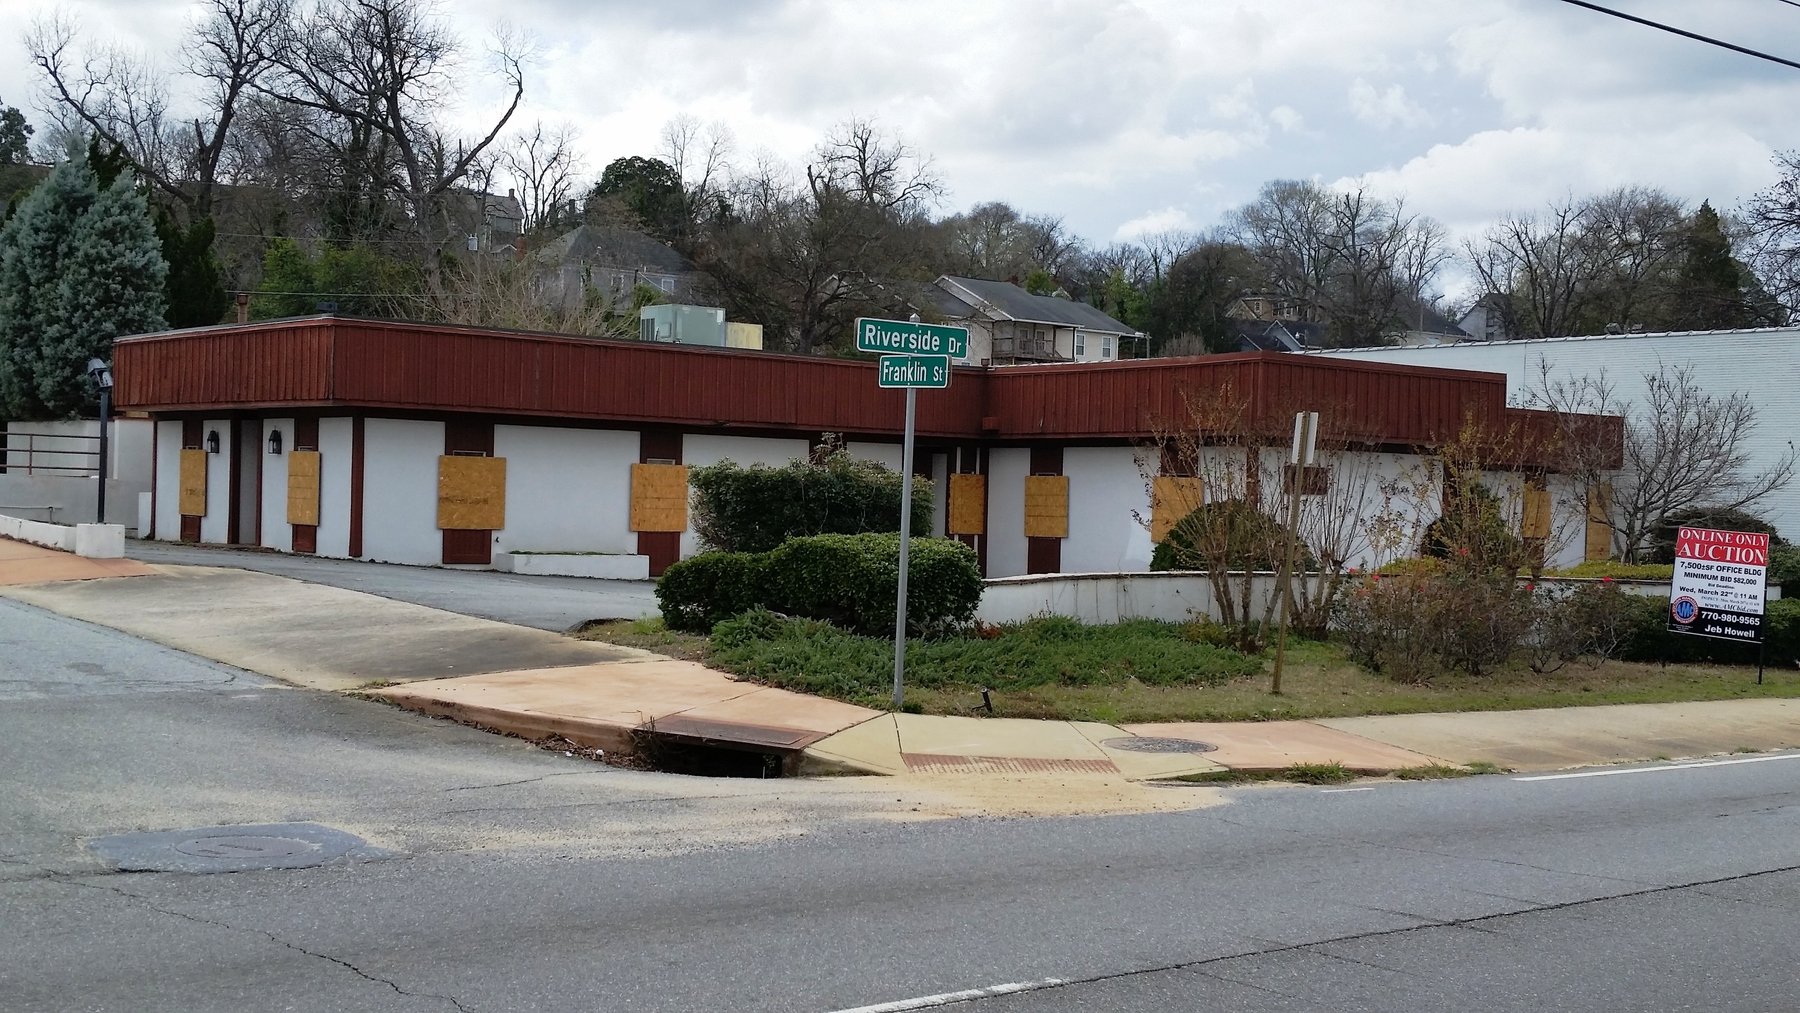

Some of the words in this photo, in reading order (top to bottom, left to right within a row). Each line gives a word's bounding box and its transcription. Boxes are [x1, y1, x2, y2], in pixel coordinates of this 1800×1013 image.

[865, 324, 940, 352] Riverside
[948, 337, 962, 354] Dr
[882, 361, 927, 382] Franklin
[933, 365, 943, 382] St
[1680, 528, 1733, 544] ONLINE
[1735, 534, 1767, 547] ONLY
[1678, 542, 1766, 564] AUCTION
[1683, 571, 1718, 581] MINIMUM
[1720, 575, 1732, 583] BID
[1733, 577, 1757, 586] $82,000
[1716, 565, 1742, 574] OFFICE
[1744, 568, 1762, 576] BLDG
[1679, 586, 1696, 594] Wed,
[1698, 588, 1719, 596] March
[1701, 610, 1760, 626] 770-980-9565
[1704, 624, 1722, 633] Jeb
[1724, 626, 1755, 638] Howell
